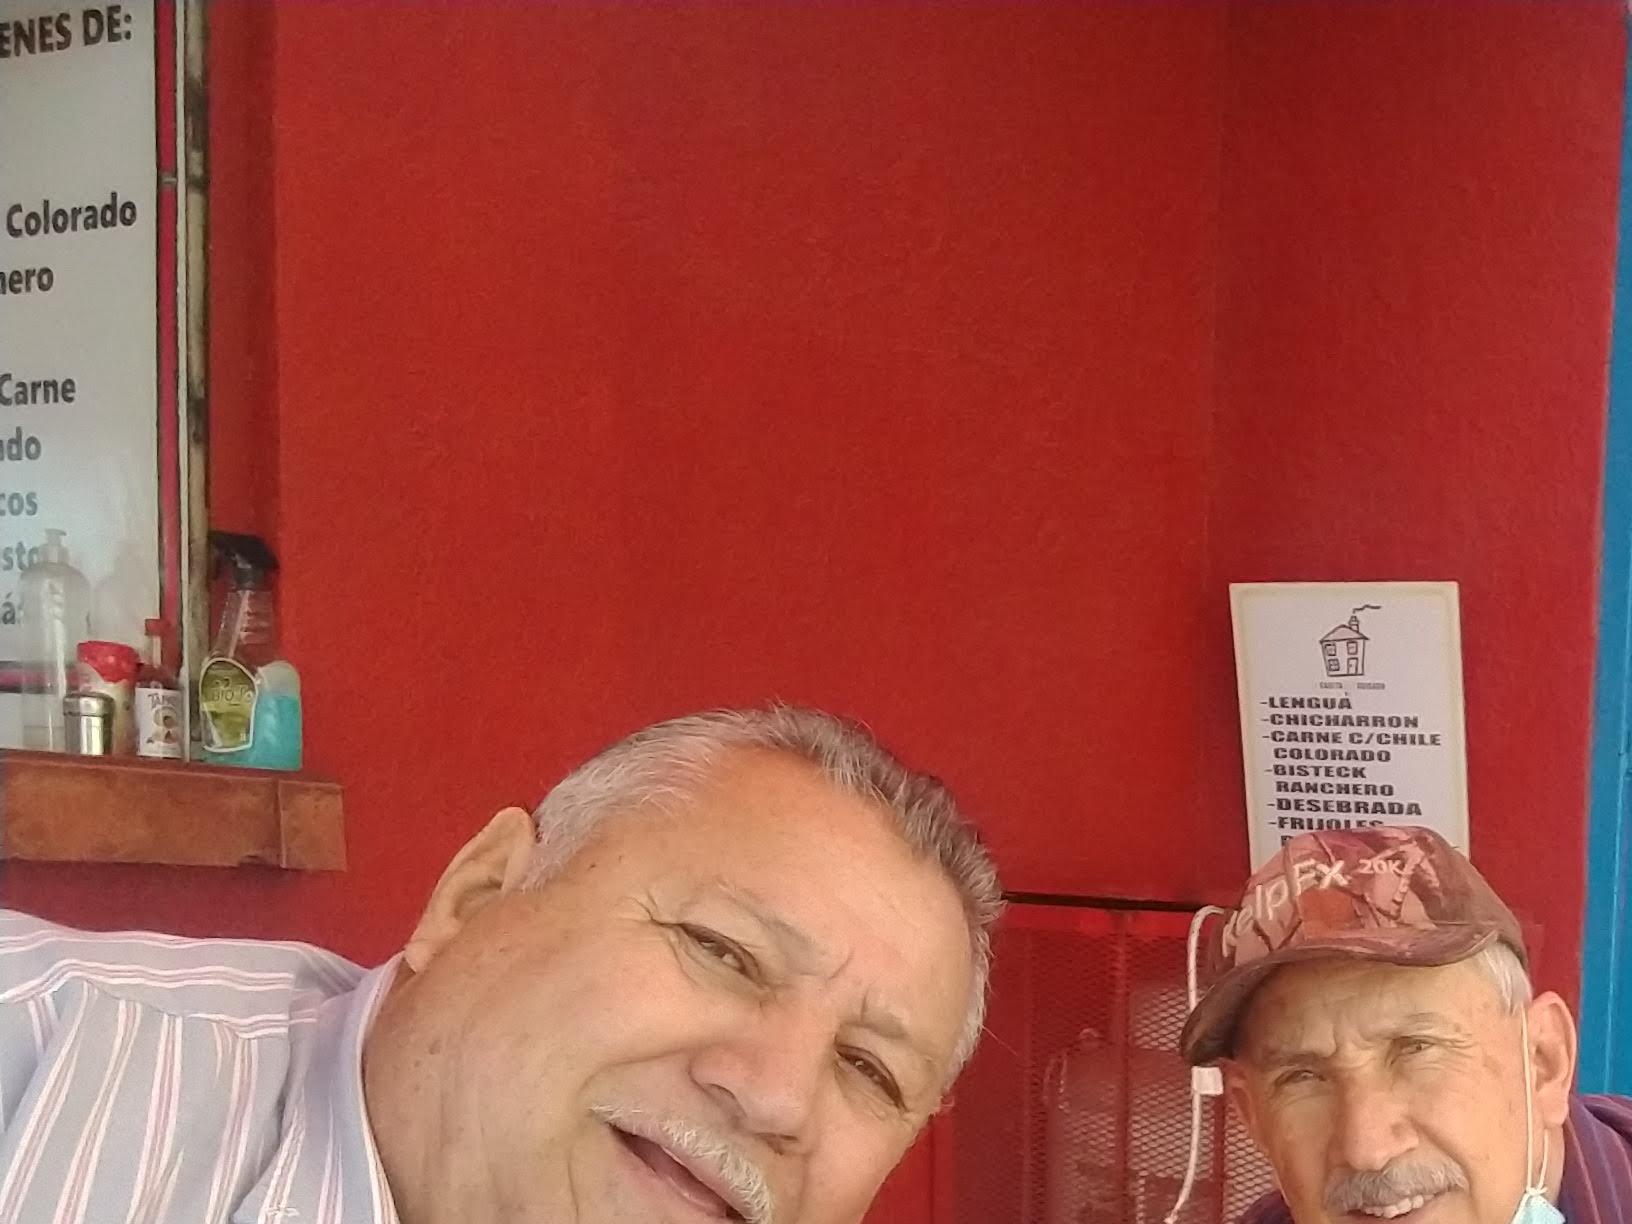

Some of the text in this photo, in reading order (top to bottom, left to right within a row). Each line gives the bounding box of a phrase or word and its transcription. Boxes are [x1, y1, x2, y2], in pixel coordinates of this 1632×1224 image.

[82, 4, 132, 46] DE:
[6, 191, 137, 238] Colorado
[0, 373, 76, 406] Carne
[1348, 732, 1442, 746] C/CHILE
[1273, 747, 1392, 762] COLORADO
[1275, 781, 1395, 796] RANCHERO
